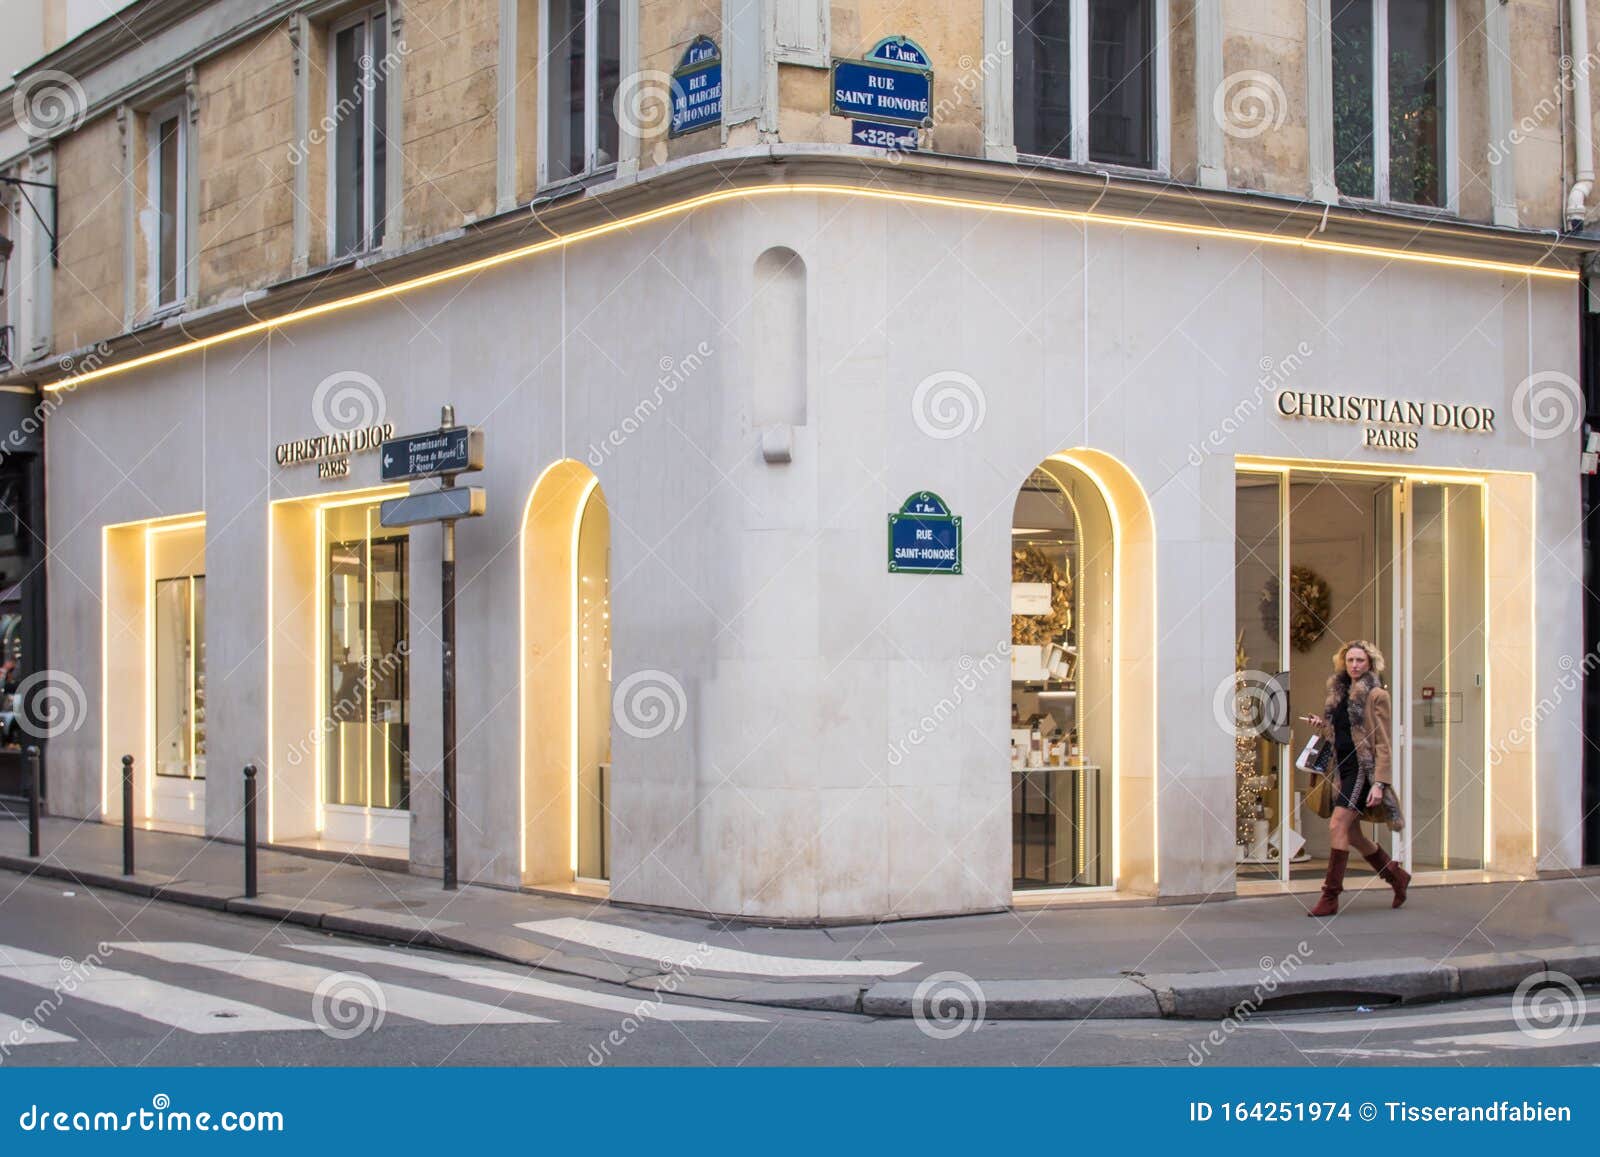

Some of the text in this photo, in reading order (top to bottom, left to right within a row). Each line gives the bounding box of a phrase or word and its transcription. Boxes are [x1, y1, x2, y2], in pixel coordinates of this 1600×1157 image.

[689, 74, 707, 91] RUE
[868, 75, 895, 91] RUE
[675, 82, 721, 110] DU MARCHÉ
[835, 89, 928, 113] SAINT HONORÉ
[867, 129, 896, 147] 326
[1277, 390, 1496, 431] CHRISTIAN DIOR
[275, 423, 394, 465] CHRISTIAN DIOR
[408, 437, 448, 453] Commissariat
[1365, 428, 1419, 449] PARIS
[318, 459, 349, 479] PARIS
[915, 529, 933, 540] RUE
[895, 547, 955, 560] SAINT-HONORÉ
